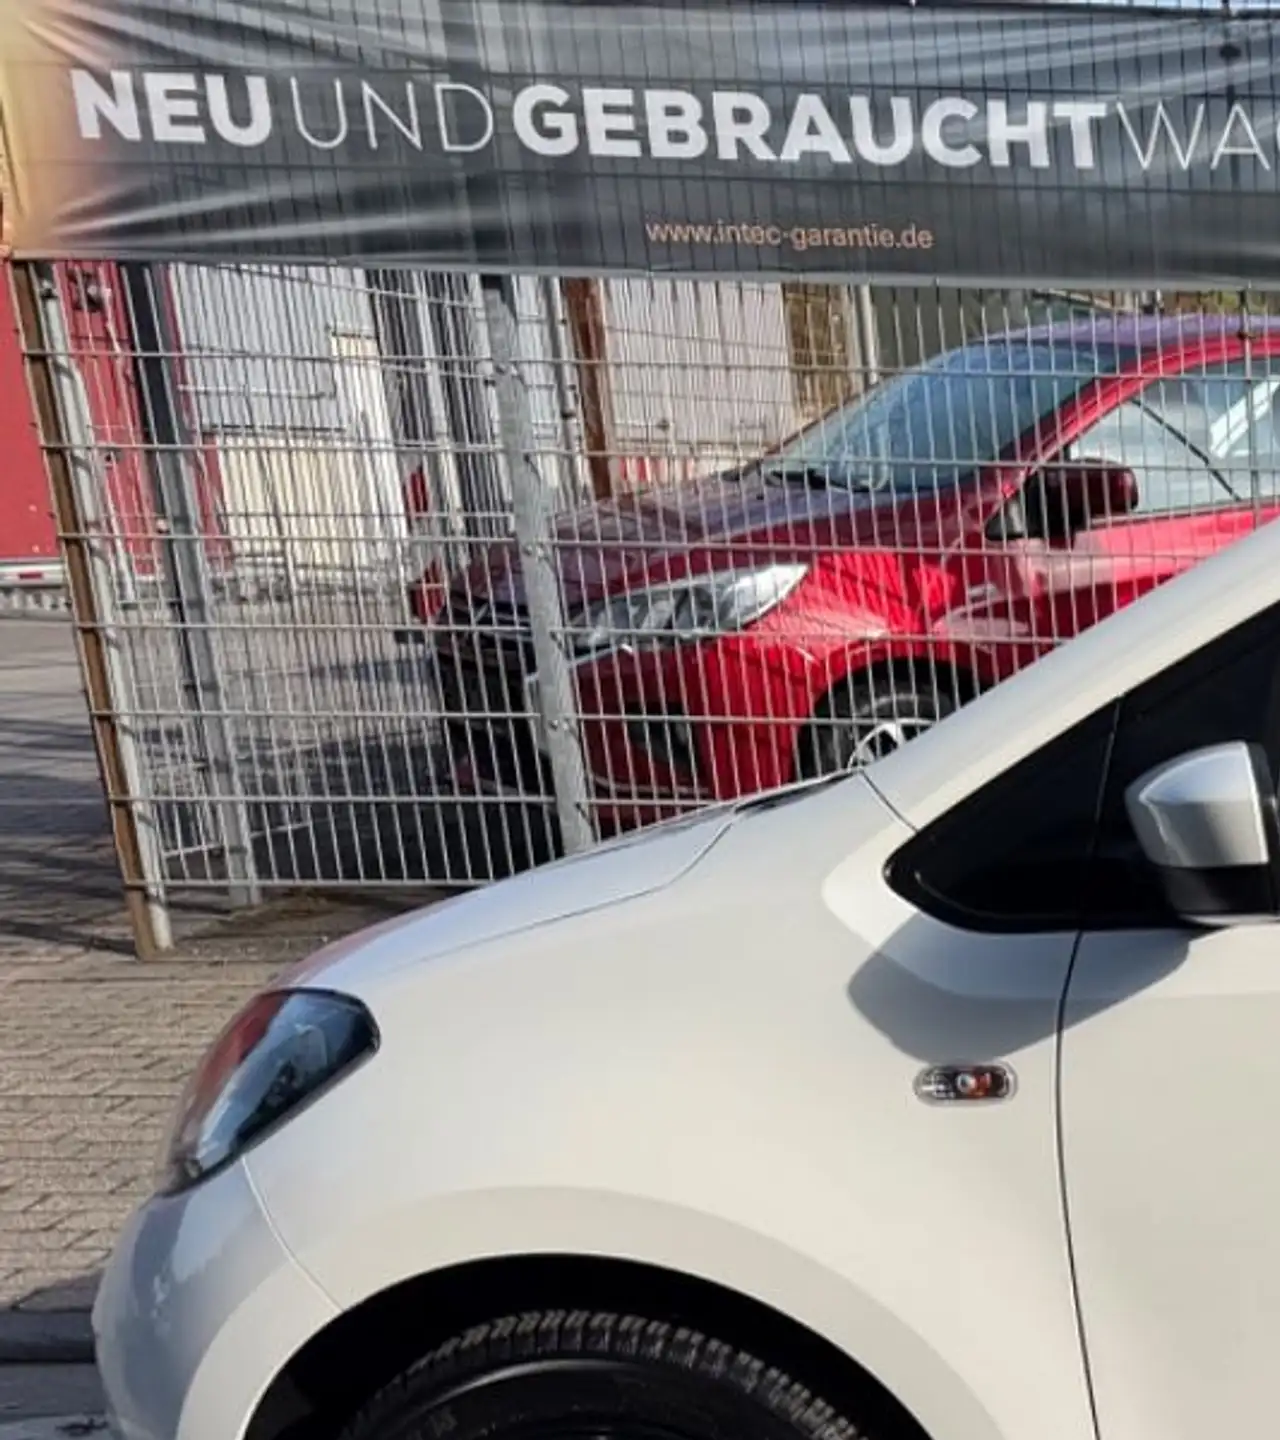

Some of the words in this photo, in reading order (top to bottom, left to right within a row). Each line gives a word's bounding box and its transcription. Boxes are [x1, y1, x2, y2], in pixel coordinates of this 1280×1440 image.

[69, 69, 273, 146] NEU
[290, 77, 495, 152] UND
[645, 218, 935, 250] www.intec-garantie.de
